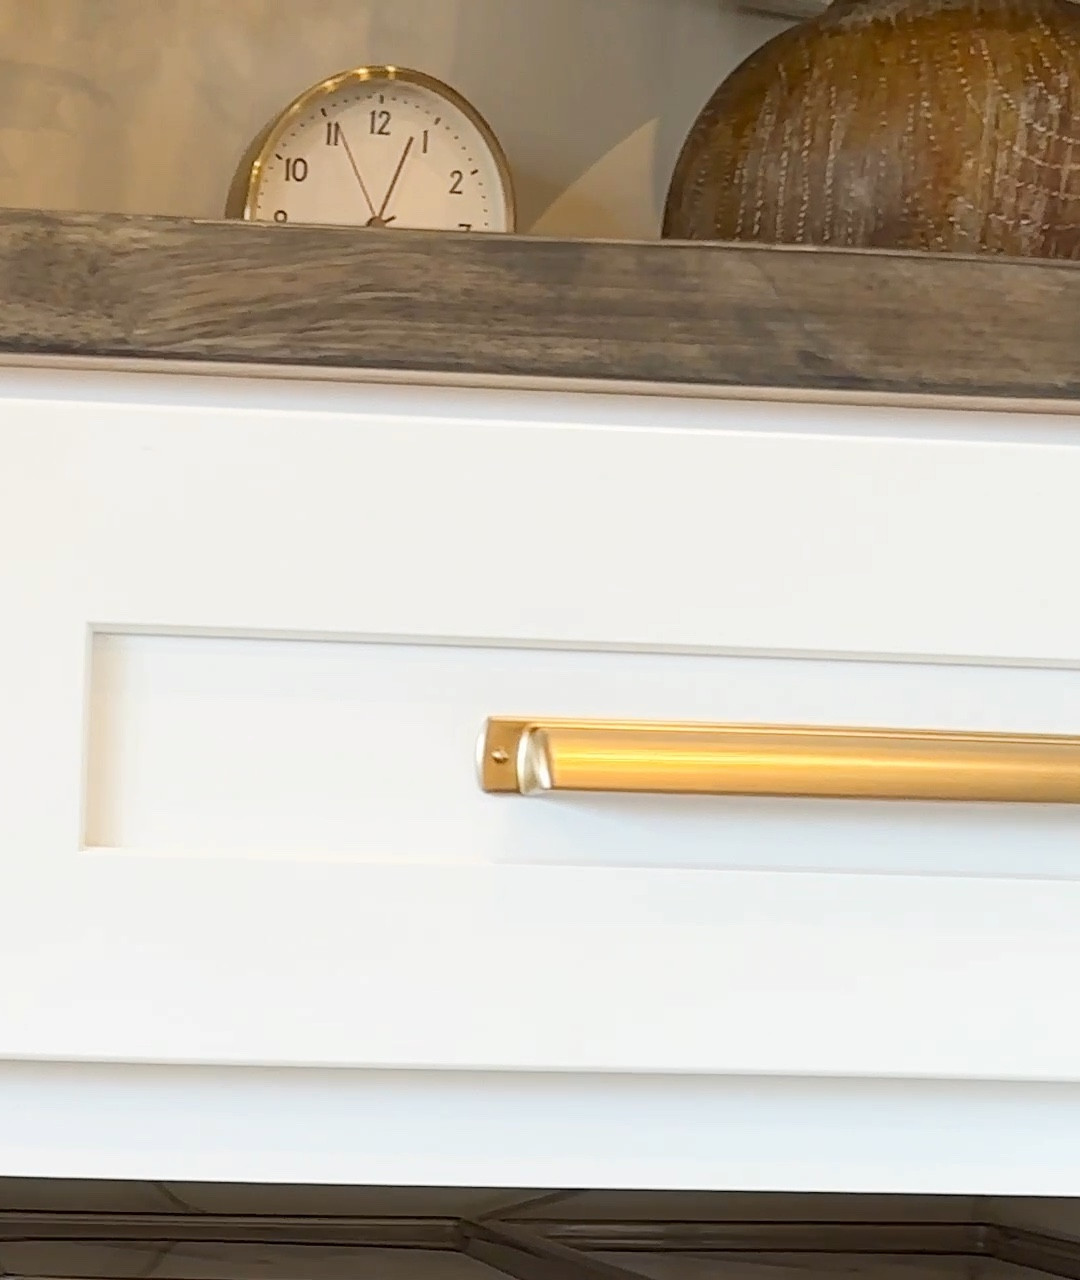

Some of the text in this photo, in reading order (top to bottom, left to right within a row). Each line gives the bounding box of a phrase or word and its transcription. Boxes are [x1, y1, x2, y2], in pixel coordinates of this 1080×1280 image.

[326, 122, 340, 146] 11
[370, 110, 391, 135] 12
[423, 130, 428, 153] 1
[284, 158, 308, 181] 10
[449, 170, 463, 194] 2
